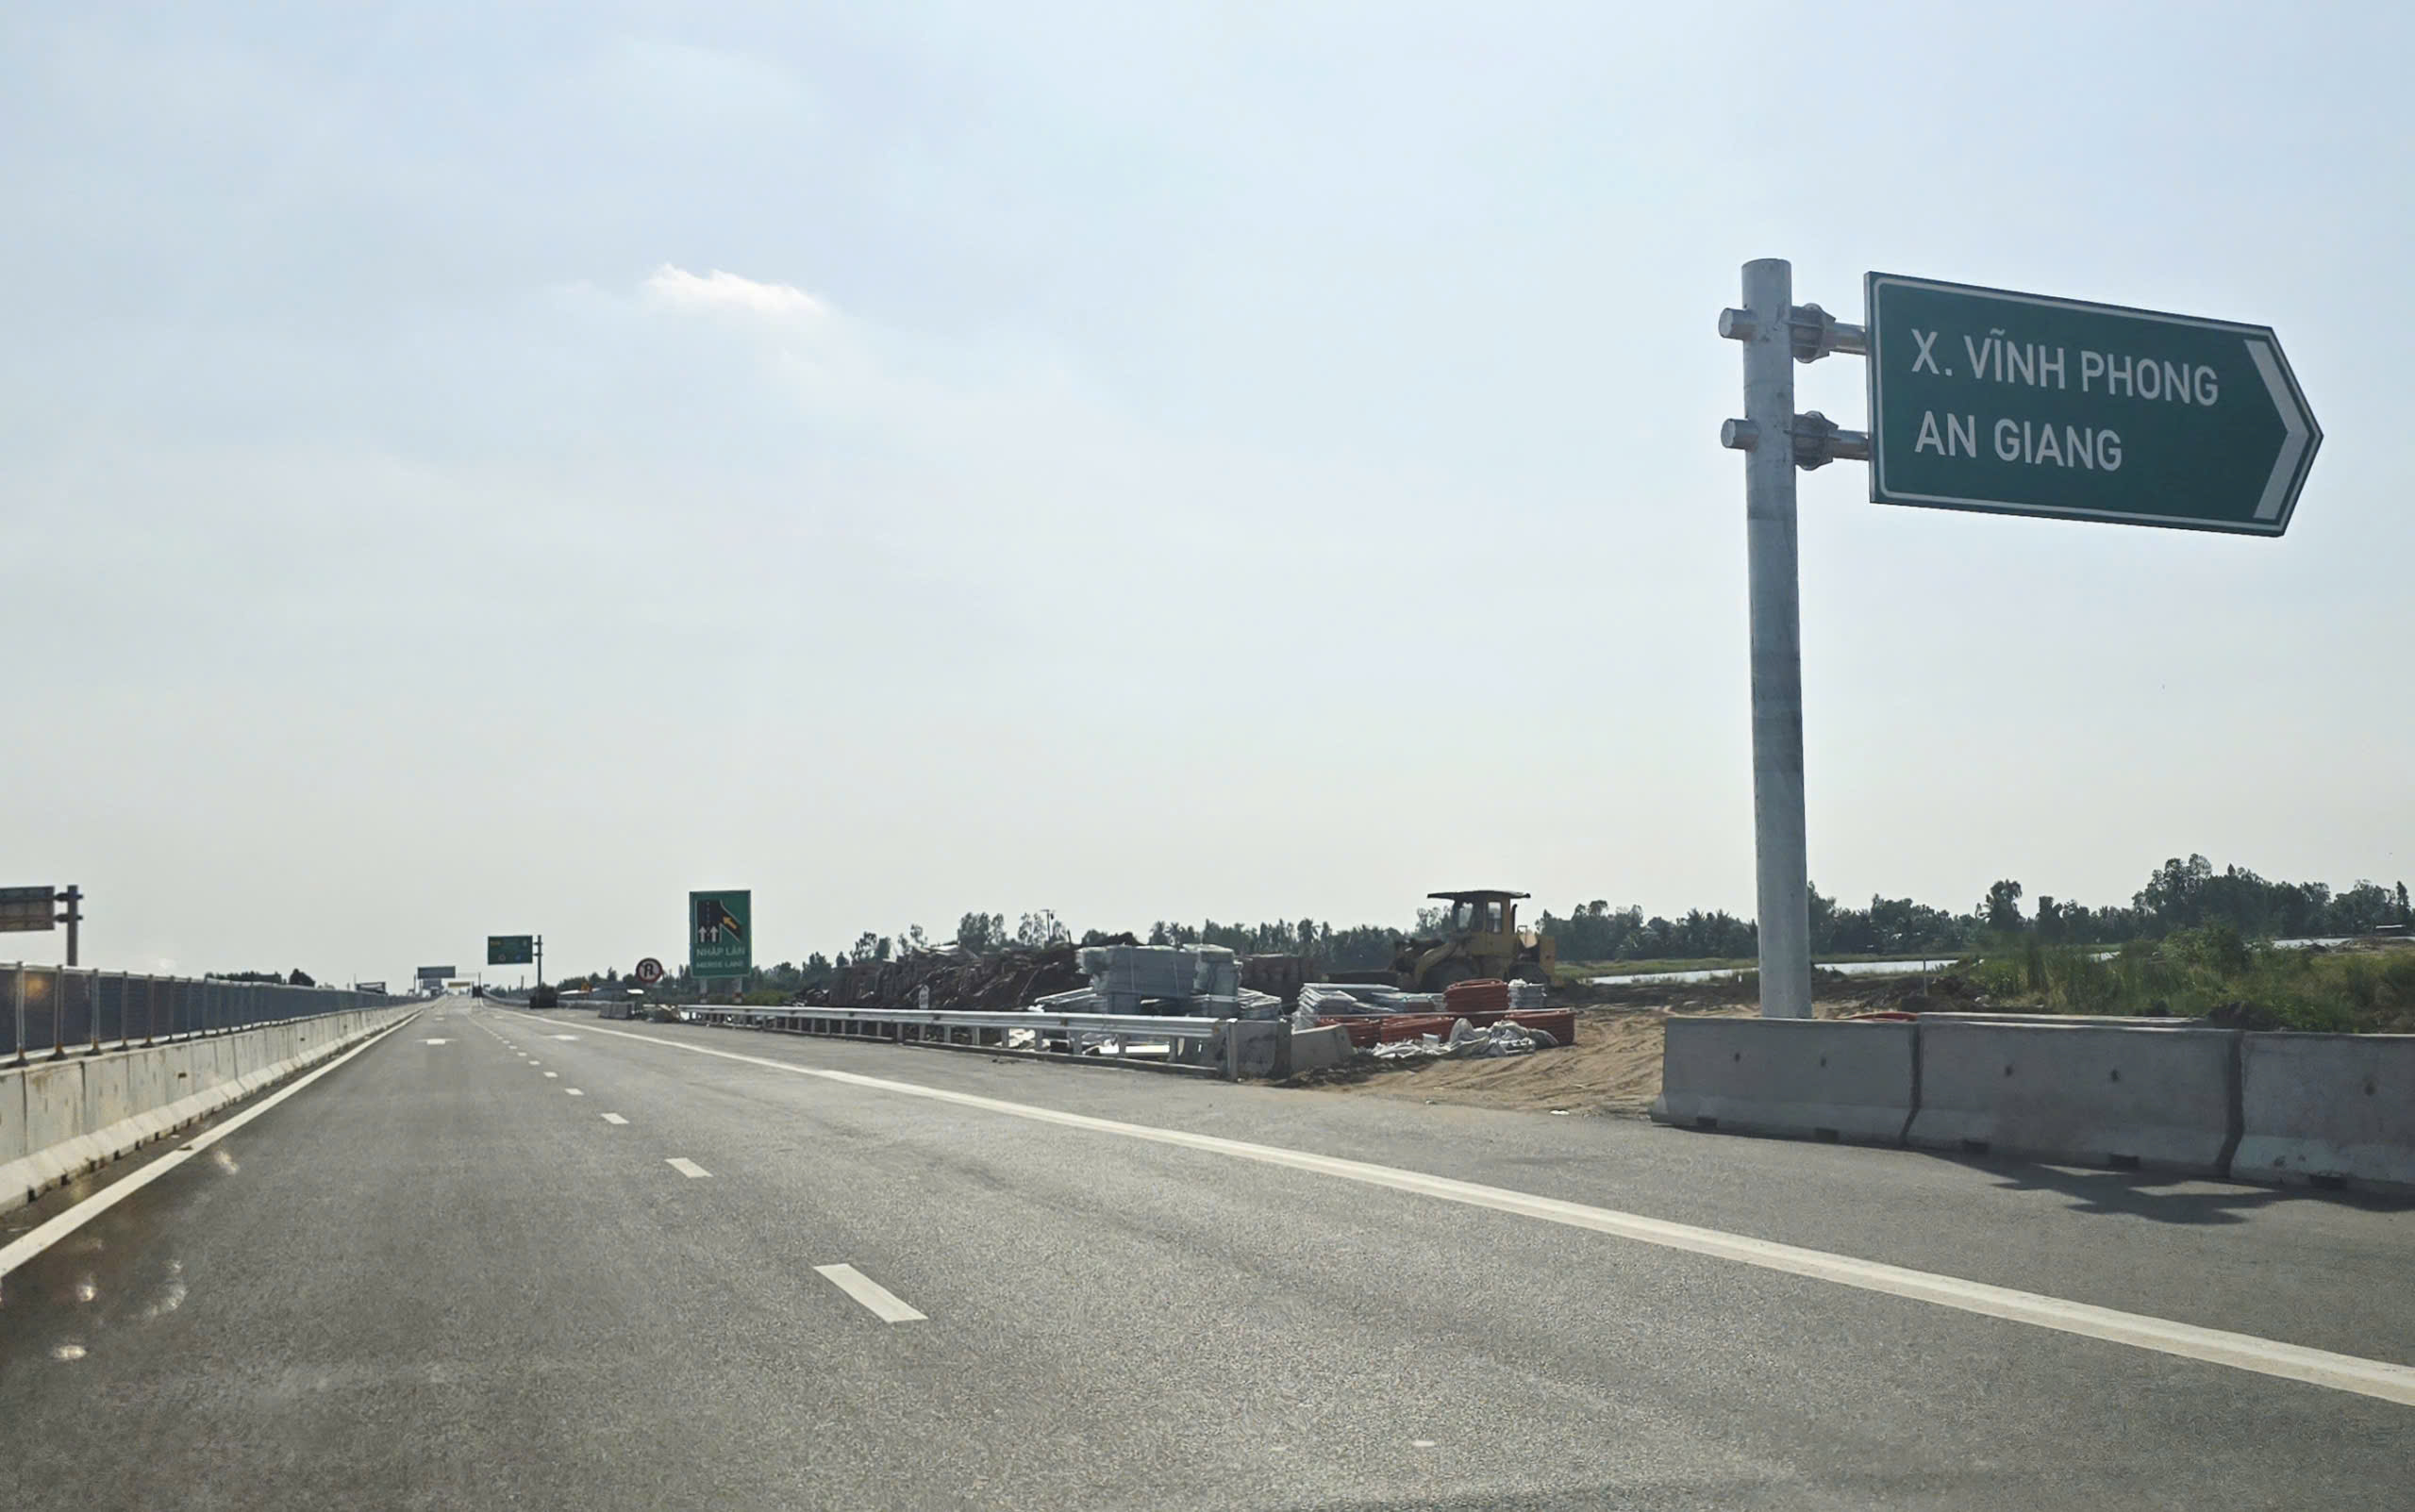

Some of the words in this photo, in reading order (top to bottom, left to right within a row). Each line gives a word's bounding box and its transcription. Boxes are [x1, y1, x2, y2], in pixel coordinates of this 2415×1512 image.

[1910, 328, 1953, 377] X.
[1963, 327, 2066, 390] VĨNH
[2080, 350, 2218, 407] PHONG
[1914, 410, 1977, 458] AN
[1994, 418, 2123, 472] GIANG
